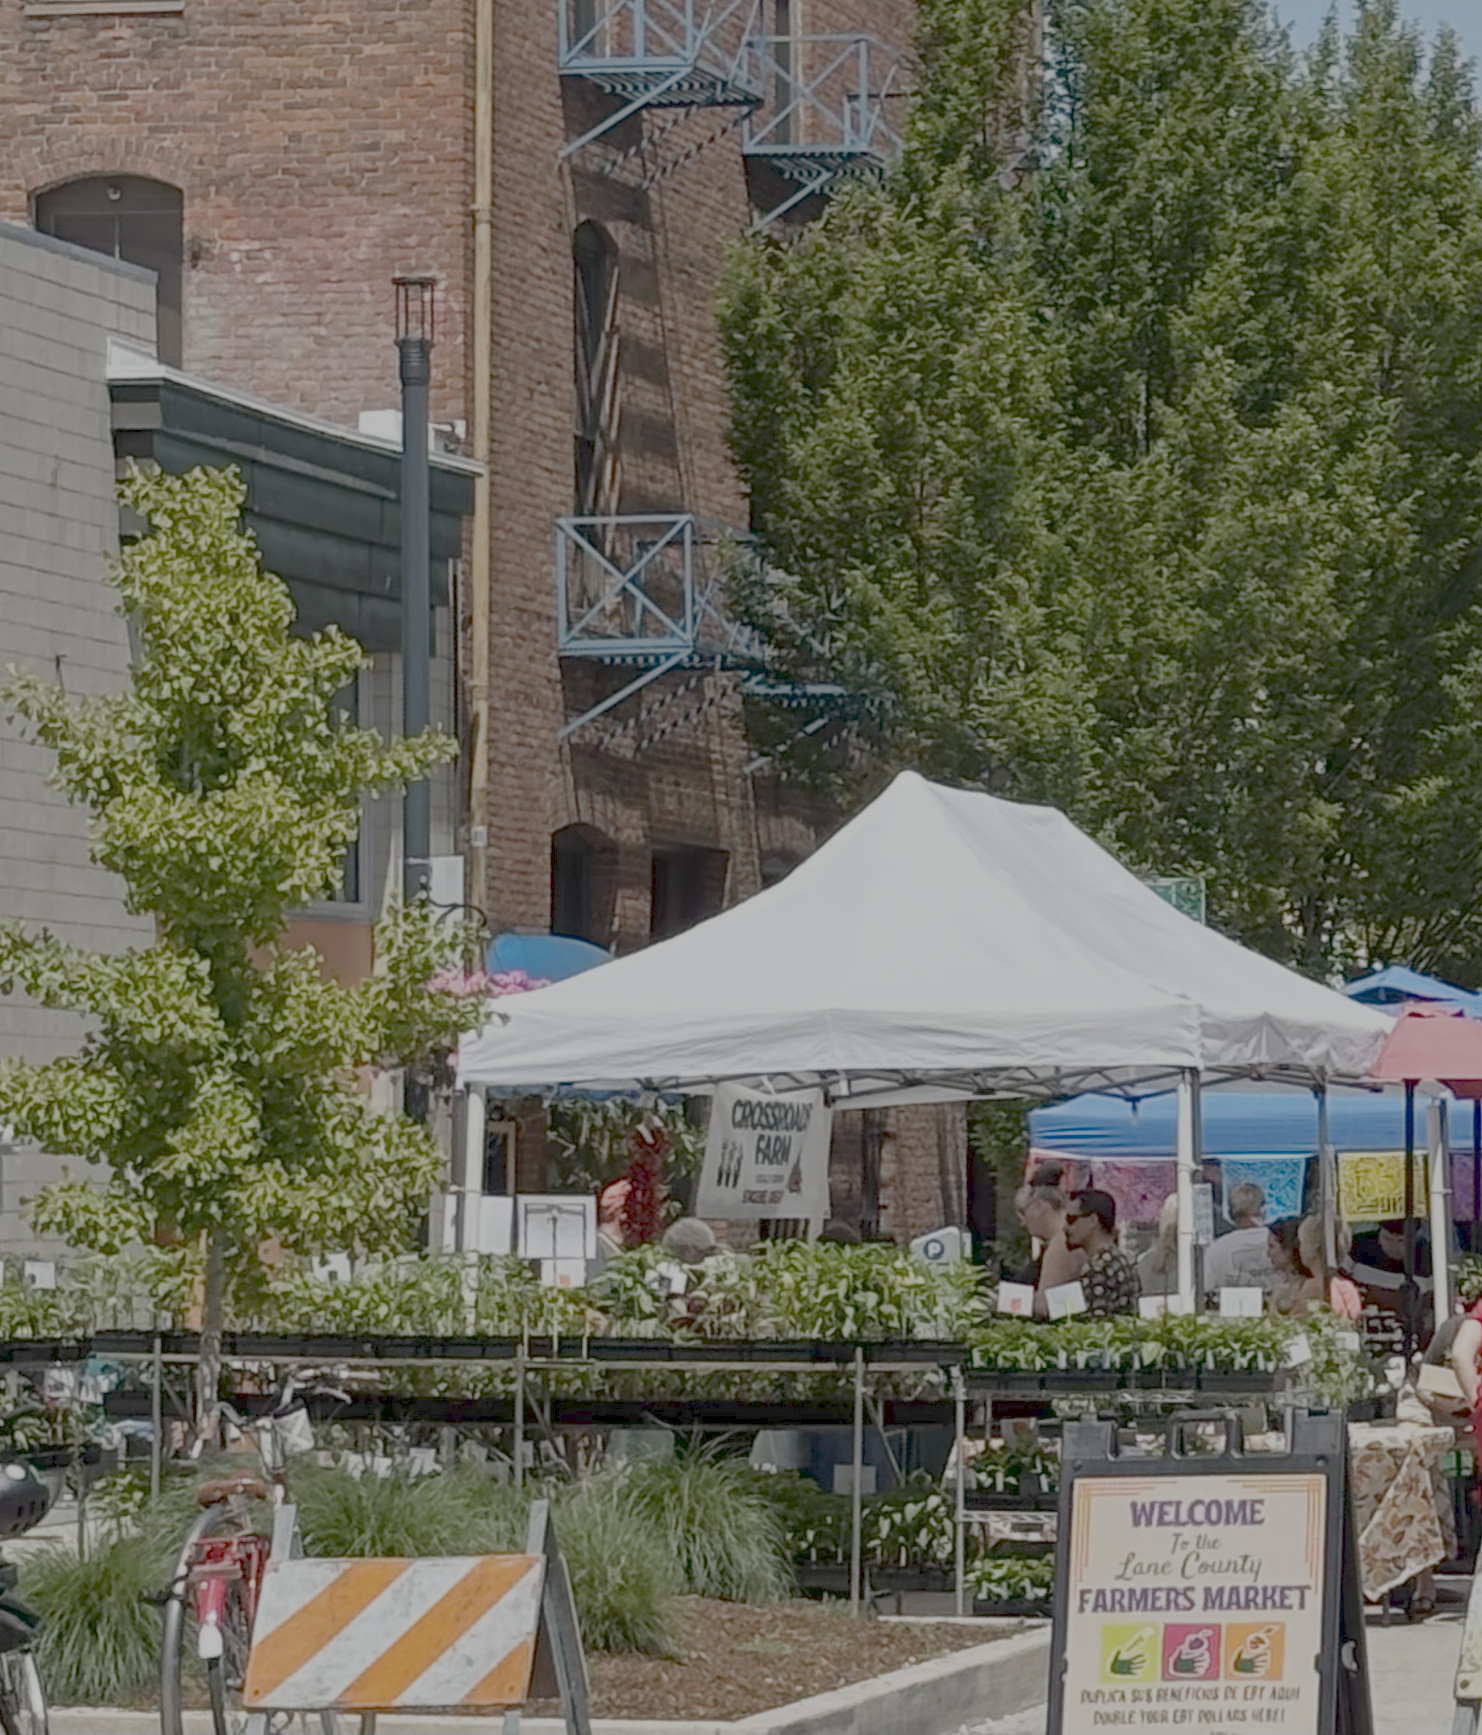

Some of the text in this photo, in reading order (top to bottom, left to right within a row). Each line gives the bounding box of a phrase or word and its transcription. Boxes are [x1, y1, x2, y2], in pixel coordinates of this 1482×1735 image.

[755, 1134, 792, 1166] FARM
[1130, 1499, 1265, 1528] WELCOME
[1171, 1532, 1220, 1554] To the
[1114, 1551, 1263, 1583] Lane County
[1077, 1585, 1312, 1614] FARMERS MARKET
[1243, 1684, 1266, 1701] EBT
[1094, 1709, 1136, 1726] DOUBLE
[1140, 1708, 1169, 1724] YOUR
[1172, 1707, 1194, 1724] EBT
[1198, 1708, 1248, 1724] DOLLARS
